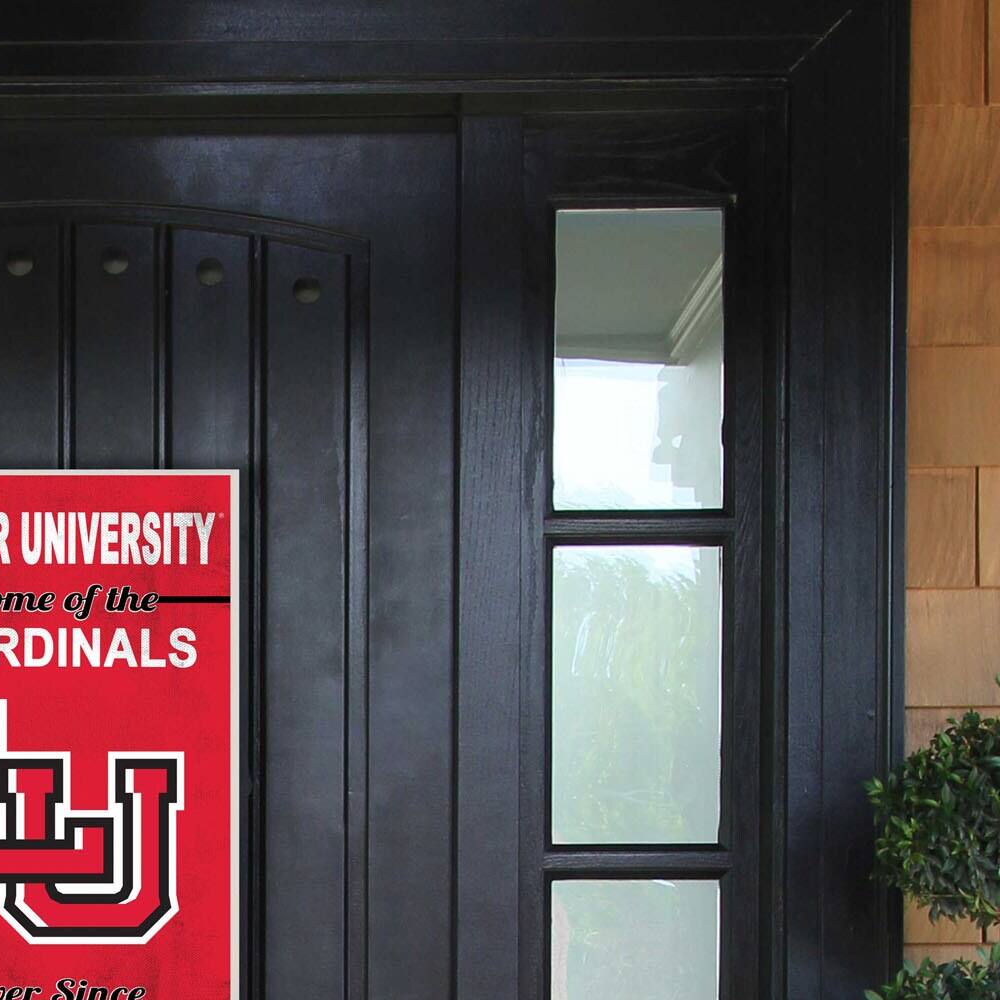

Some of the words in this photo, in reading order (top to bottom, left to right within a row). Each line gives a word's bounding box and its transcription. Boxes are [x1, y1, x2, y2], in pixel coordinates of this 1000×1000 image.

[21, 511, 216, 565] UNIVERSITY
[64, 584, 102, 620] of
[104, 584, 160, 613] the
